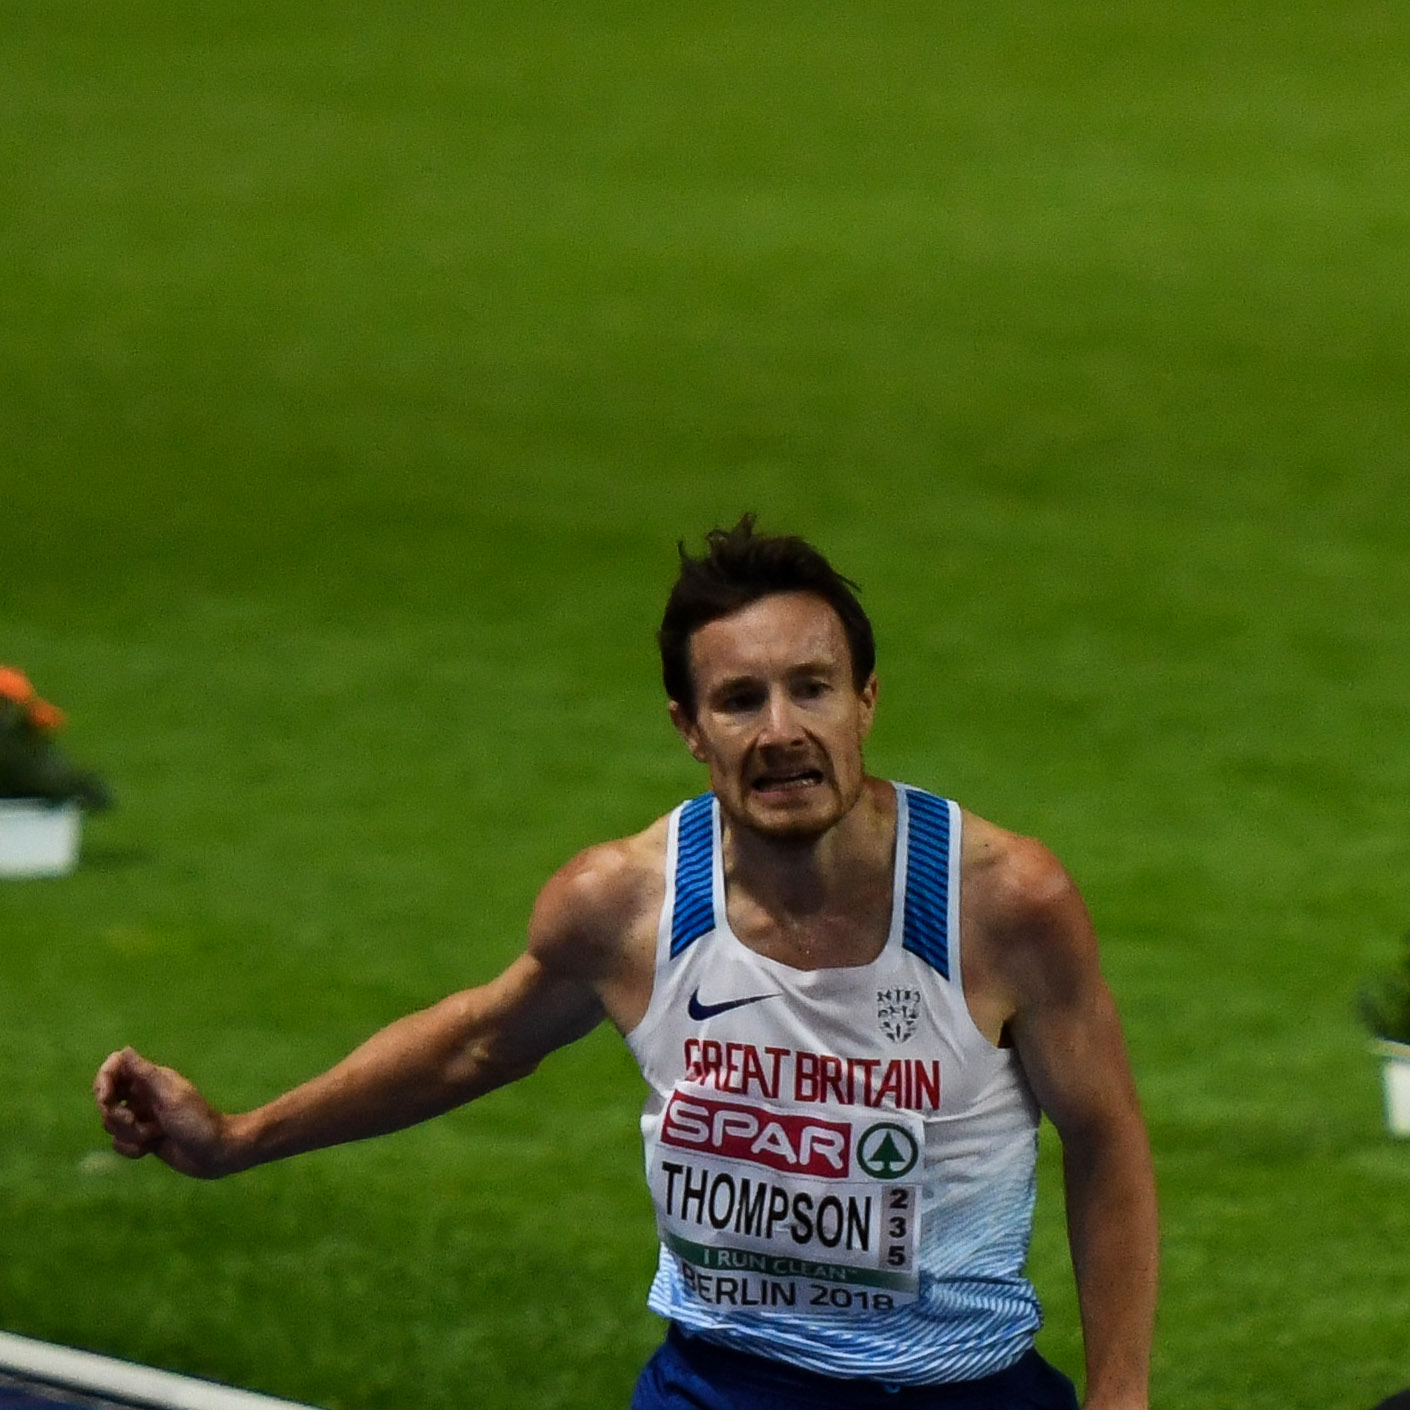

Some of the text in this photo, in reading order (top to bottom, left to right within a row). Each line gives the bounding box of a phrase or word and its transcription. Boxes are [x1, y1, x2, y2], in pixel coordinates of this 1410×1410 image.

[684, 1038, 940, 1111] GREAT BRITAIN
[666, 1100, 845, 1170] SPAR
[662, 1161, 872, 1252] THOMPSON
[886, 1189, 908, 1266] 235
[682, 1262, 895, 1311] BERLIN 2018
[704, 1249, 846, 1281] I RUN CLEAN
